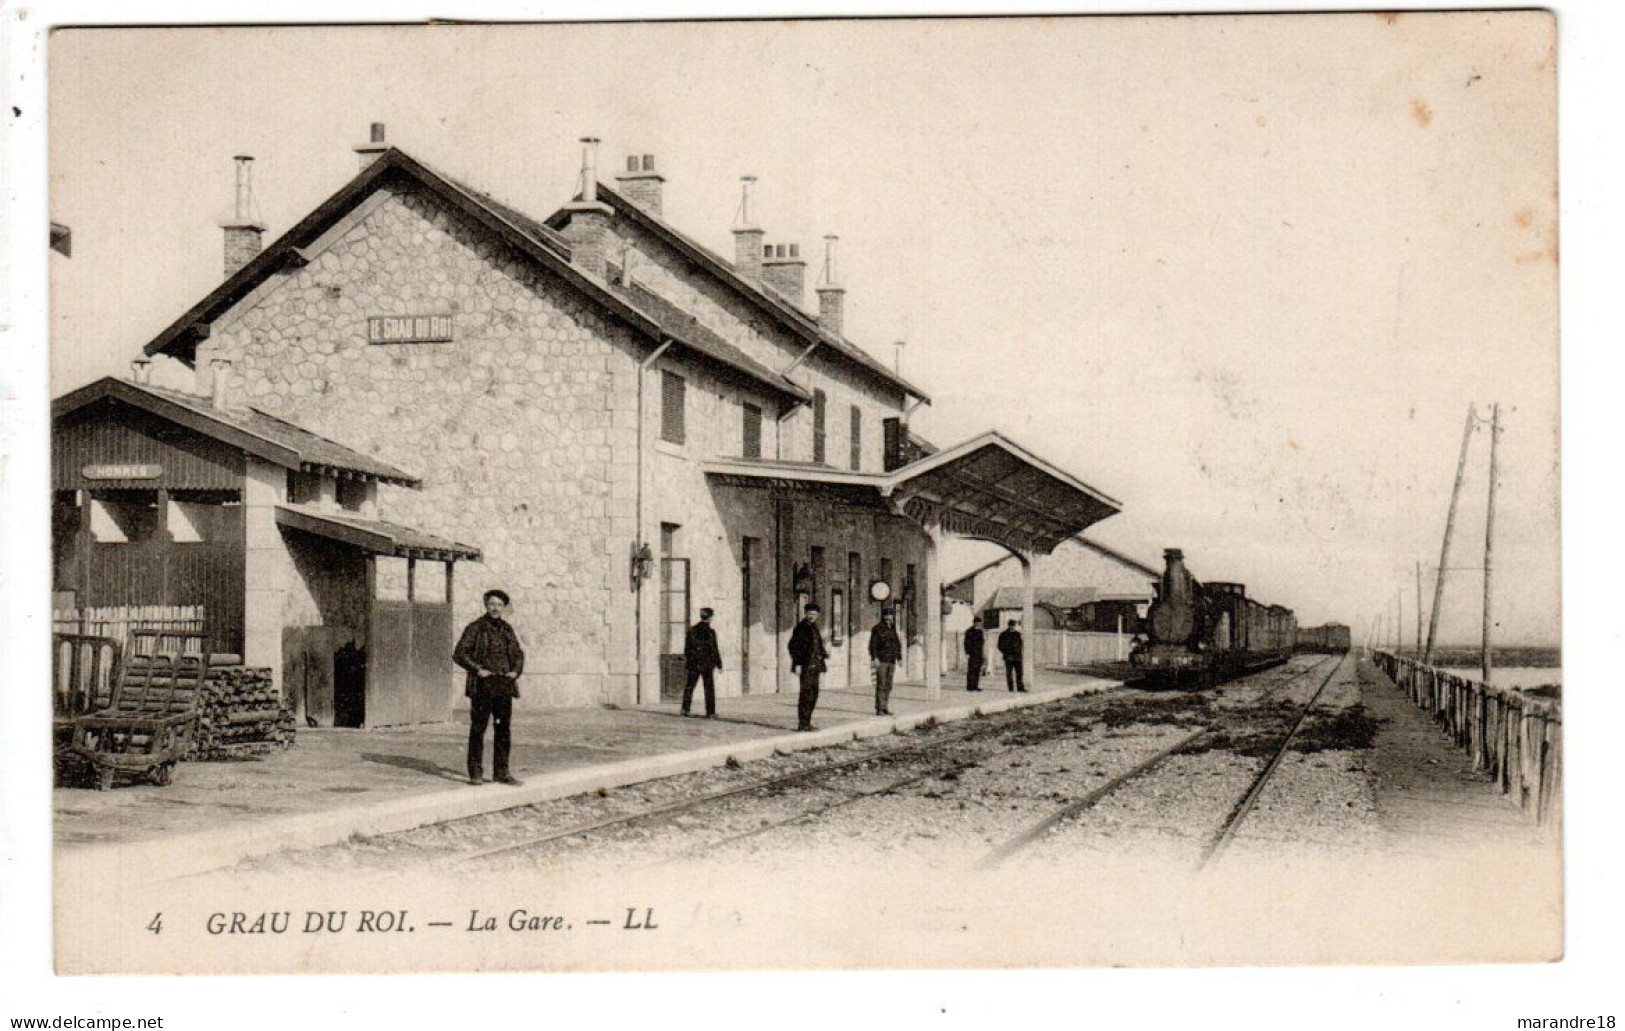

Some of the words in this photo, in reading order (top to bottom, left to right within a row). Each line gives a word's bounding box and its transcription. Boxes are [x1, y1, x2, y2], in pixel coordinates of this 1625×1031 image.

[383, 318, 413, 339] GRAU
[415, 318, 429, 338] DU
[430, 316, 451, 338] ROI
